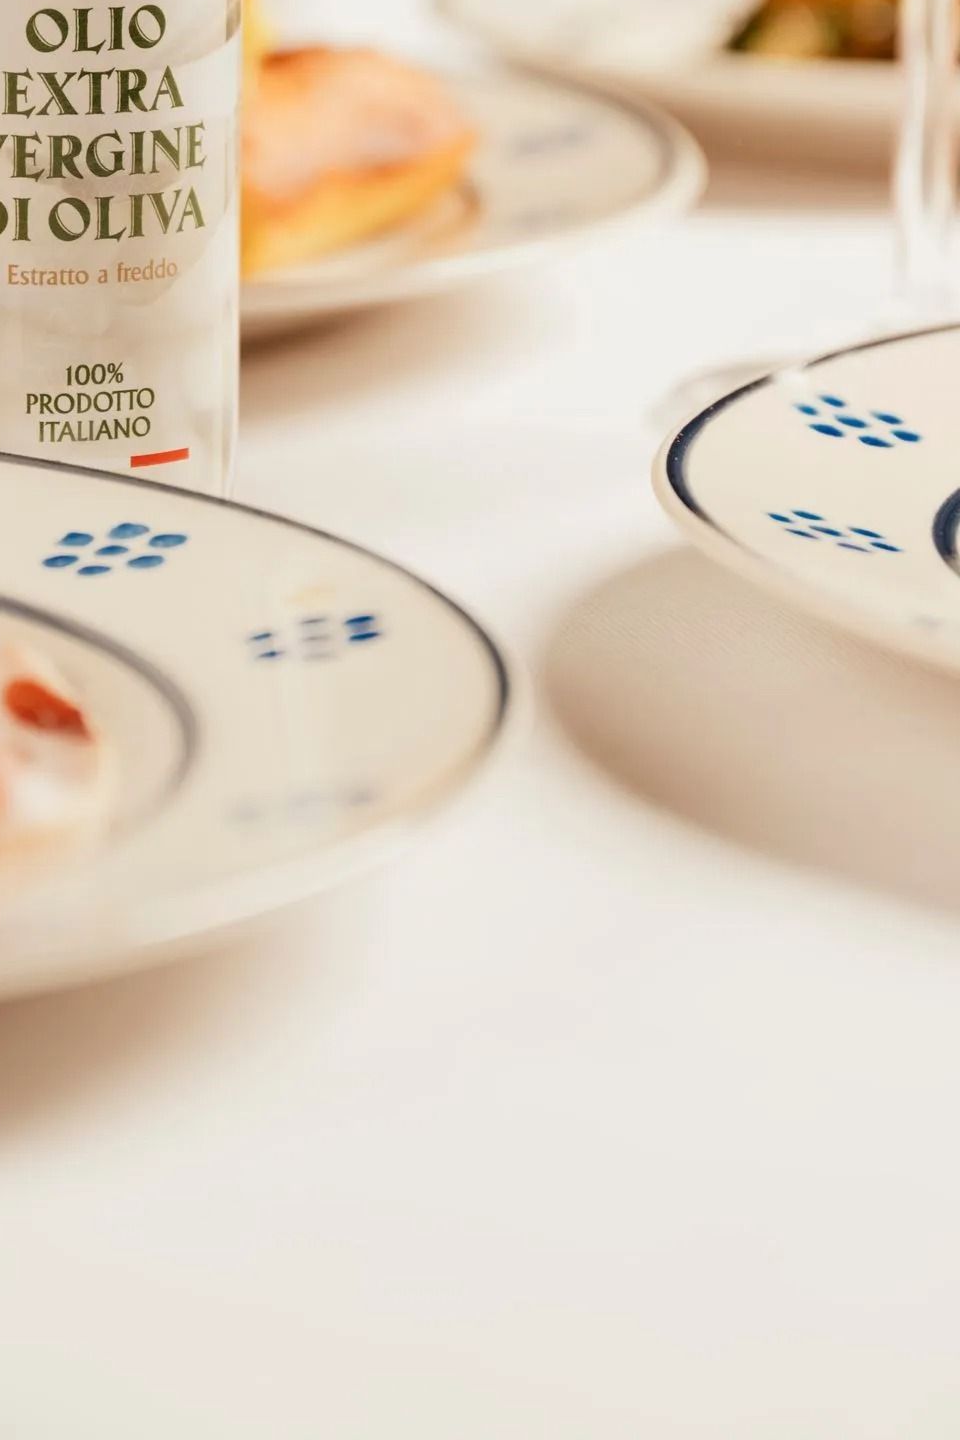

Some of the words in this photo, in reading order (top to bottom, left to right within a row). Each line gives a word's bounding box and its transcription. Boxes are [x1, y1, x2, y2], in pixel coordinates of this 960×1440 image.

[26, 4, 166, 55] OLIO
[1, 65, 184, 119] EXTRA
[48, 186, 205, 242] OLIVA
[7, 264, 89, 285] Estratto
[97, 266, 108, 284] a
[117, 258, 178, 282] freddo
[66, 362, 123, 386] 100%
[26, 388, 155, 414] PRODOTTO
[38, 416, 151, 442] ITALIANO
